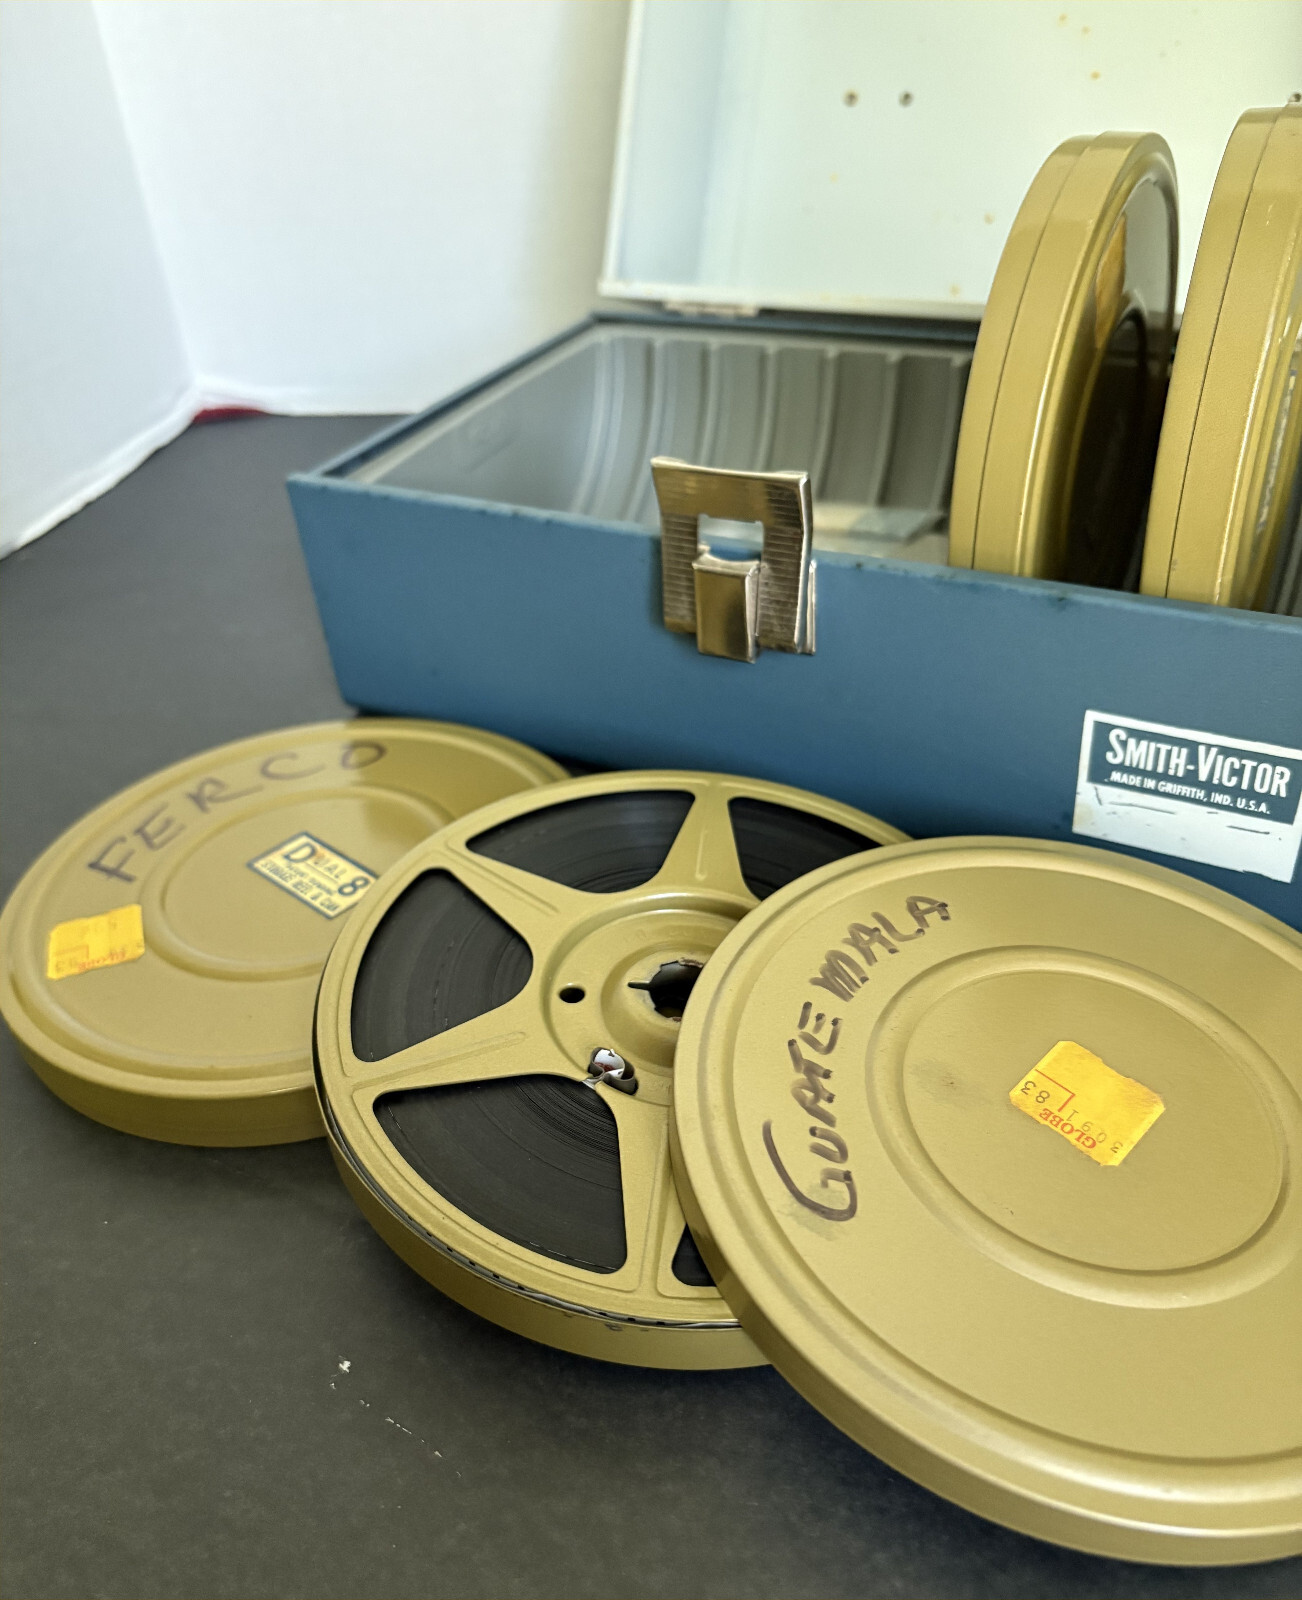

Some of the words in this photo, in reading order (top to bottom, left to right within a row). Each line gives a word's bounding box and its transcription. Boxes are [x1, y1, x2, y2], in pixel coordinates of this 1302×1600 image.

[1106, 728, 1291, 798] SMITH-VICTOR
[87, 740, 387, 883] FERCO
[1110, 770, 1142, 787] MADE
[1143, 777, 1156, 790] IN
[1157, 780, 1208, 802] GRIFFITH,
[1210, 791, 1234, 807] IND.
[1236, 797, 1271, 815] U.S.A.
[338, 876, 371, 896] 8
[762, 895, 951, 1222] GUATEMALA
[1039, 1108, 1097, 1149] GLOBE
